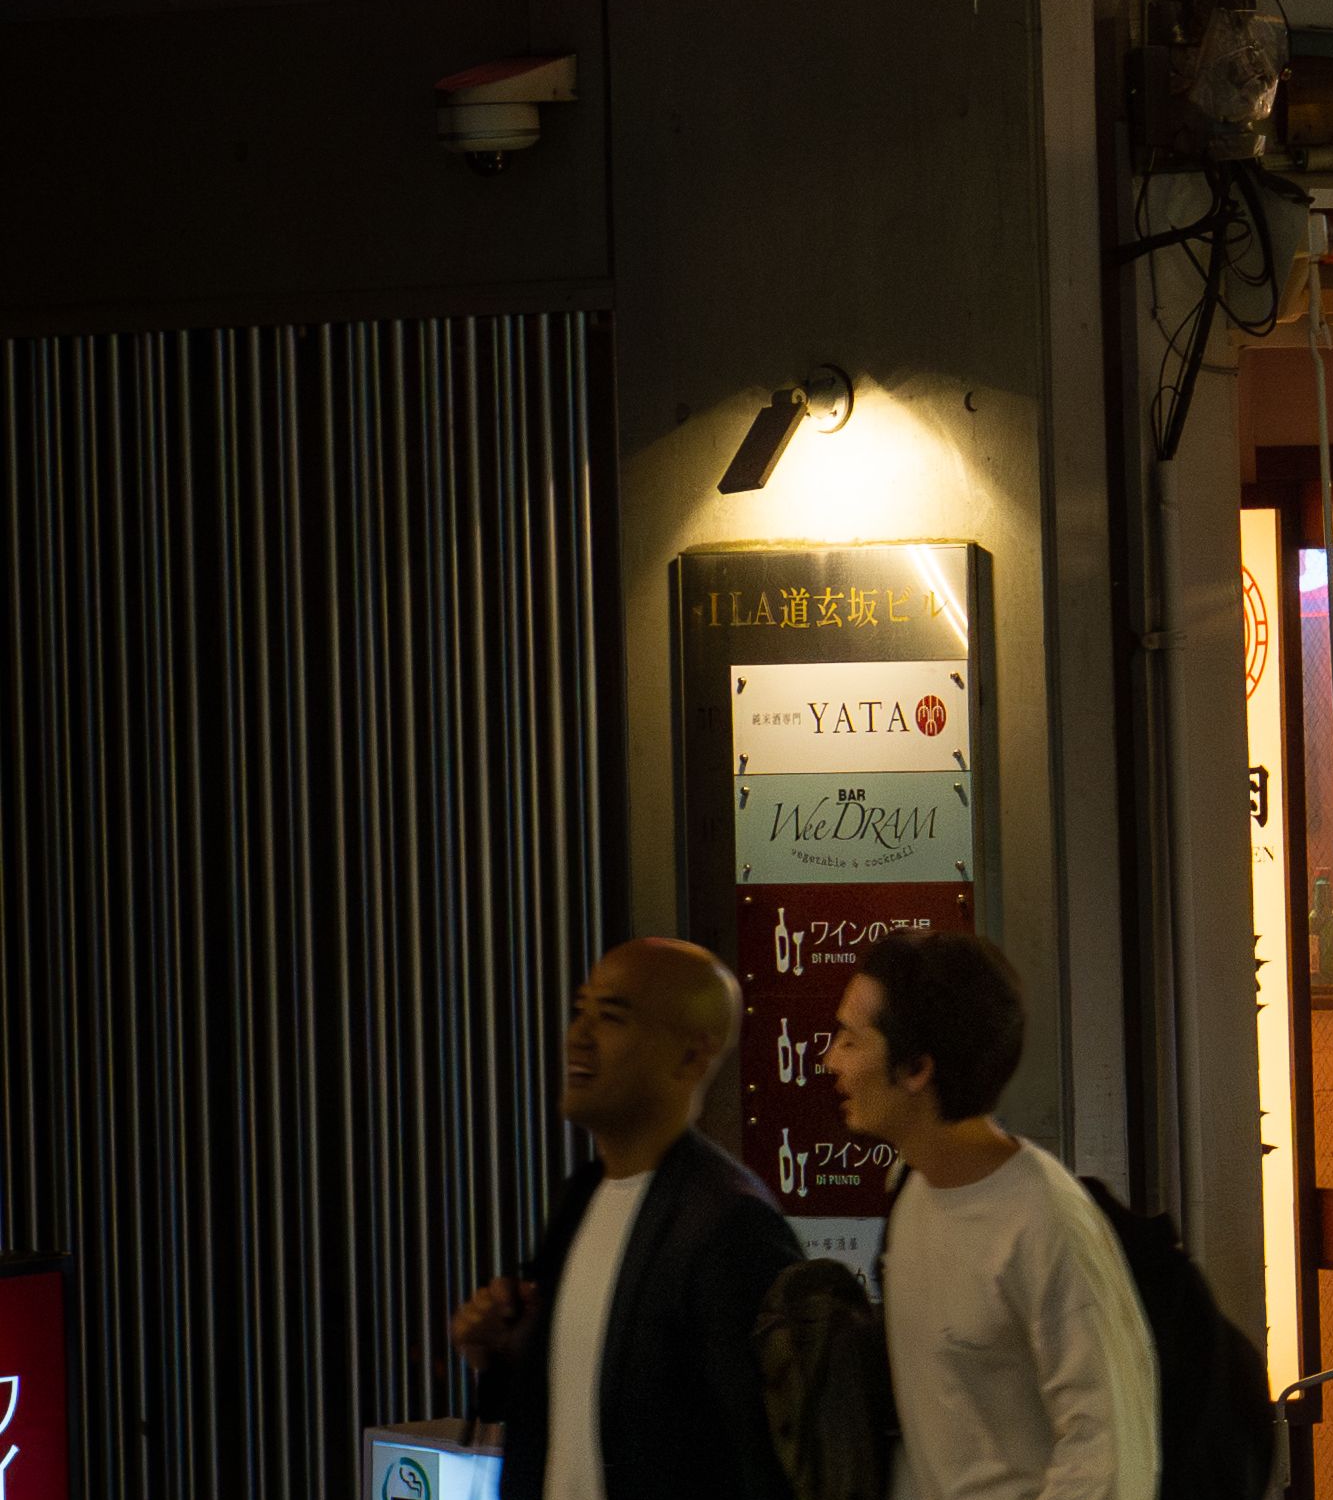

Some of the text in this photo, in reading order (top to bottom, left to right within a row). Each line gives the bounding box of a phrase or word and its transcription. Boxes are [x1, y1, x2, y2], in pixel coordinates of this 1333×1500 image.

[691, 586, 949, 629] ILA道玄坂ビル
[807, 700, 911, 735] YATA
[838, 788, 866, 801] BAR
[769, 795, 938, 850] Wee DRAM
[864, 844, 915, 869] cocktail
[824, 952, 857, 965] PUNTO
[814, 1141, 899, 1168] ワインの
[828, 1173, 861, 1186] PUNTO
